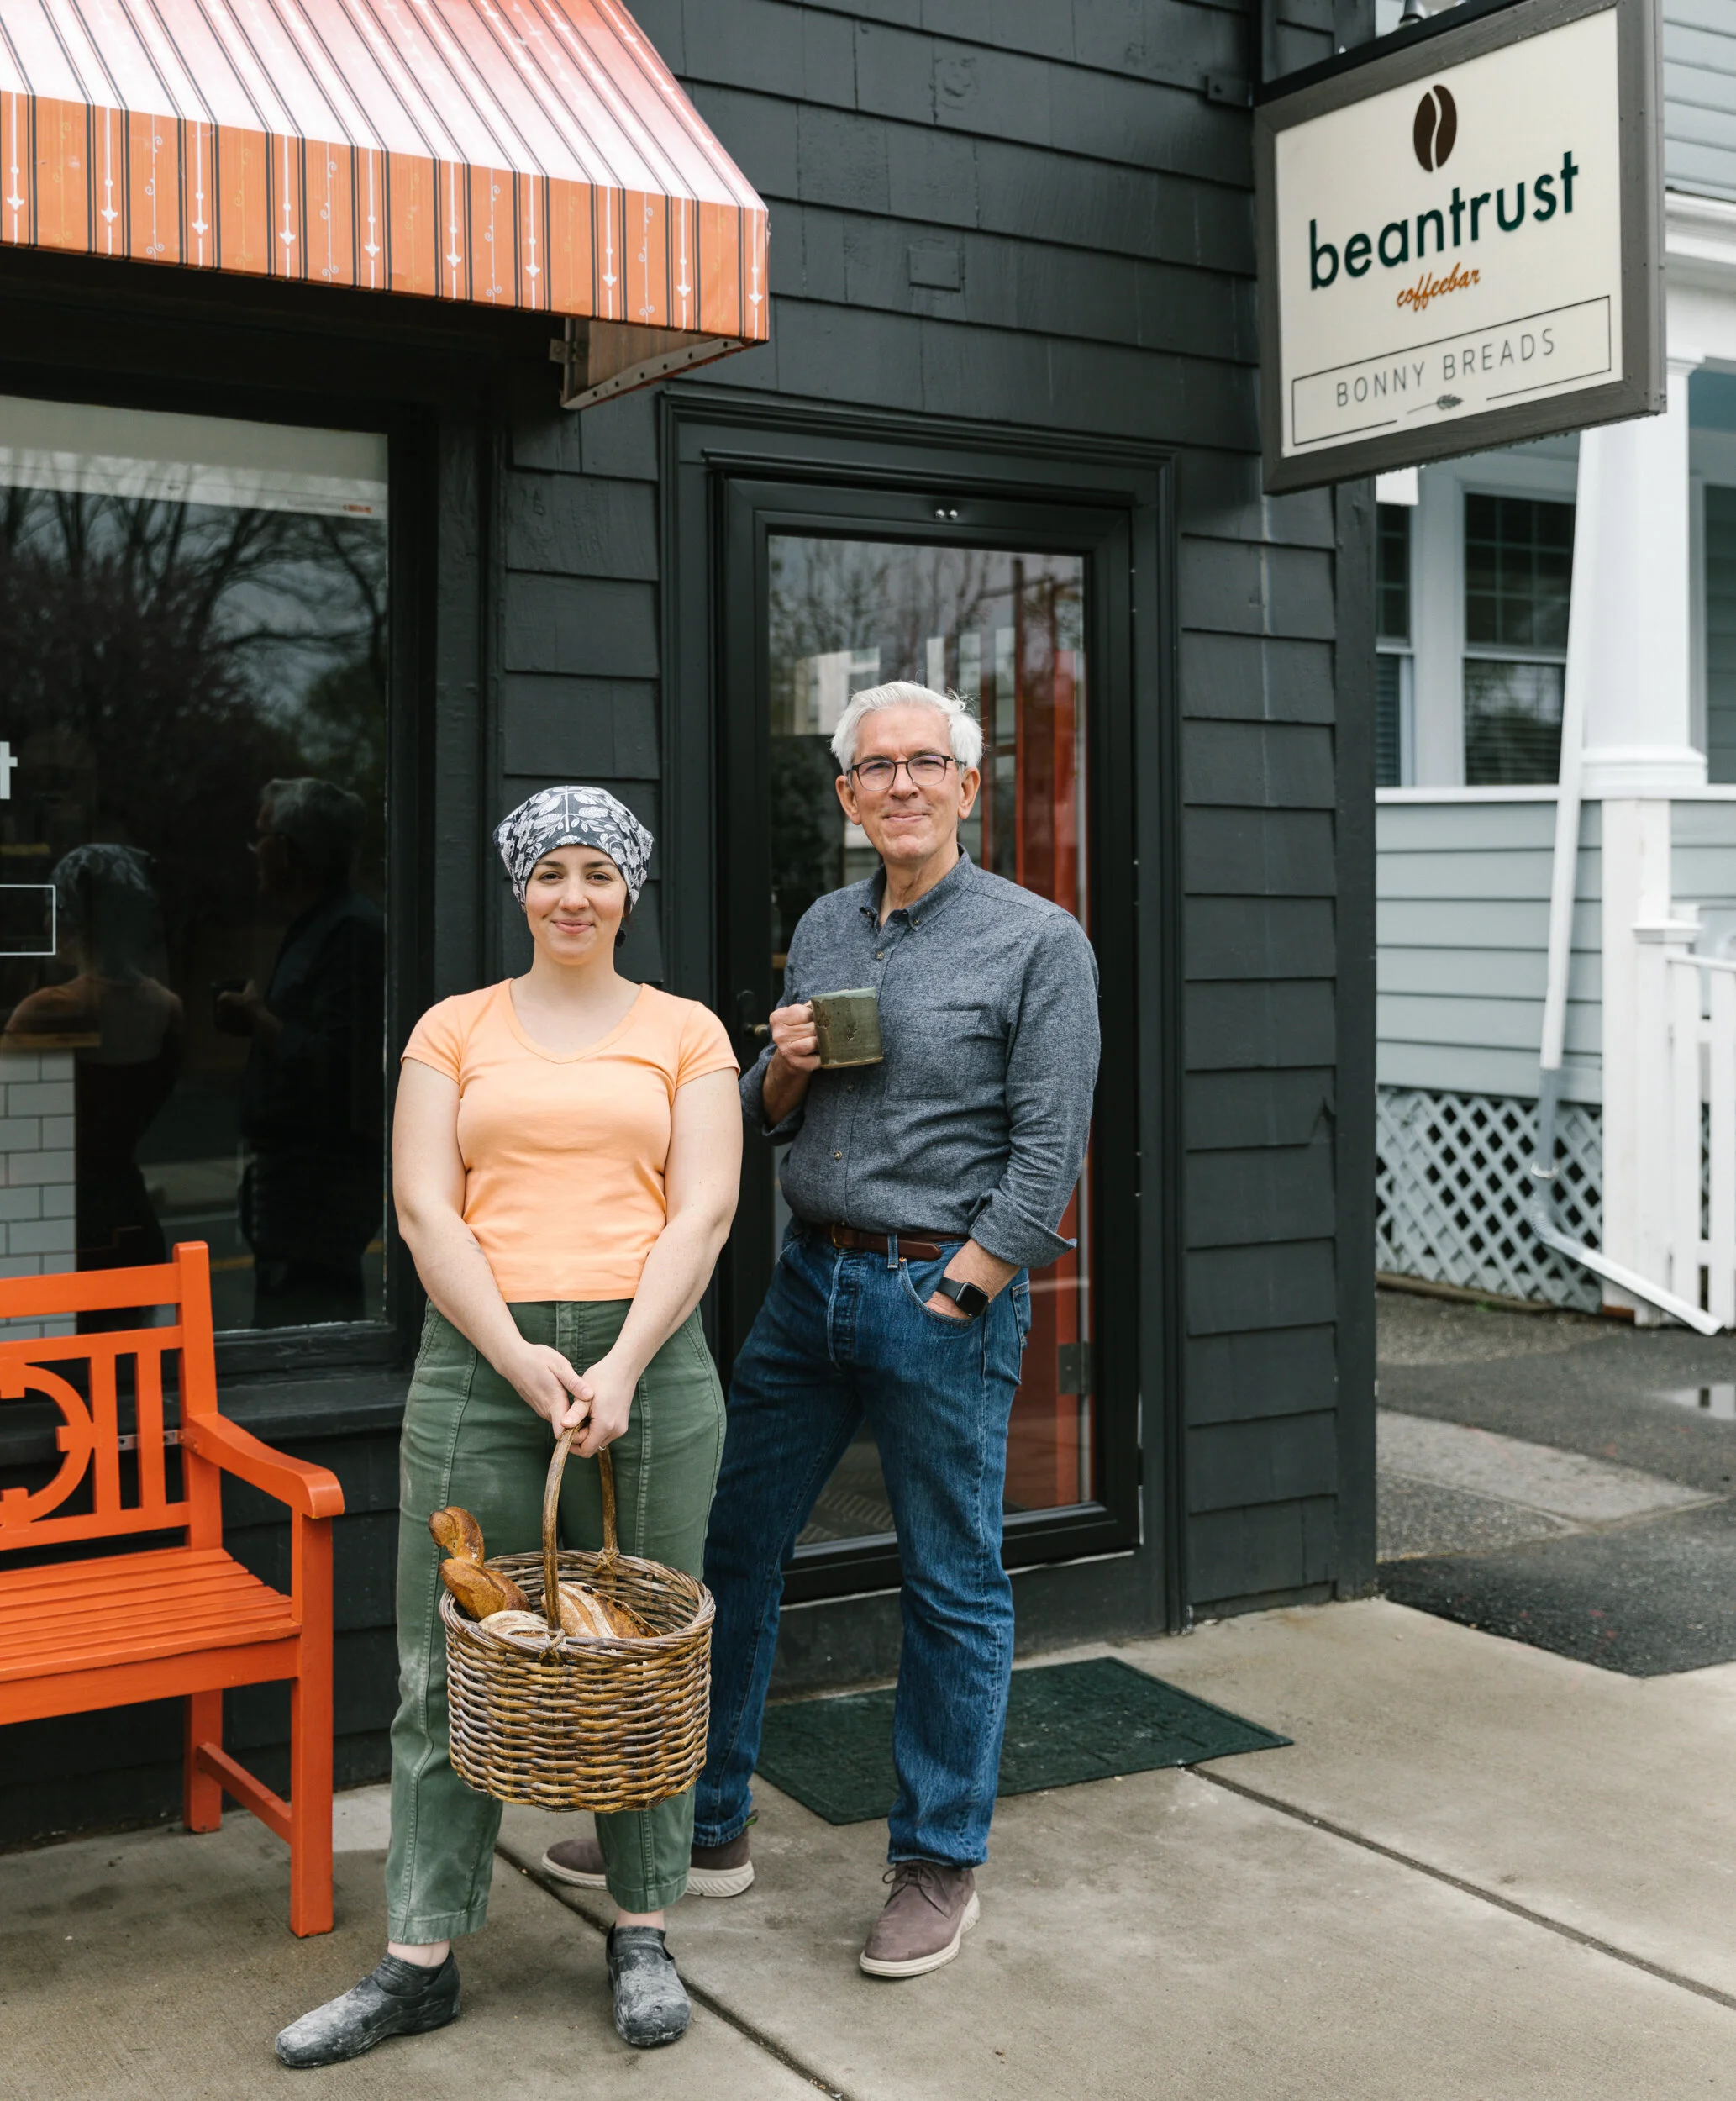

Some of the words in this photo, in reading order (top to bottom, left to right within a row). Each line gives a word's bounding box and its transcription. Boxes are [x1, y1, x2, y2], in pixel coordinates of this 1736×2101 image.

[1309, 151, 1579, 291] beantrust
[1397, 262, 1481, 312] coffeebar
[1336, 362, 1425, 408] BONNY
[1443, 329, 1555, 380] BREADS
